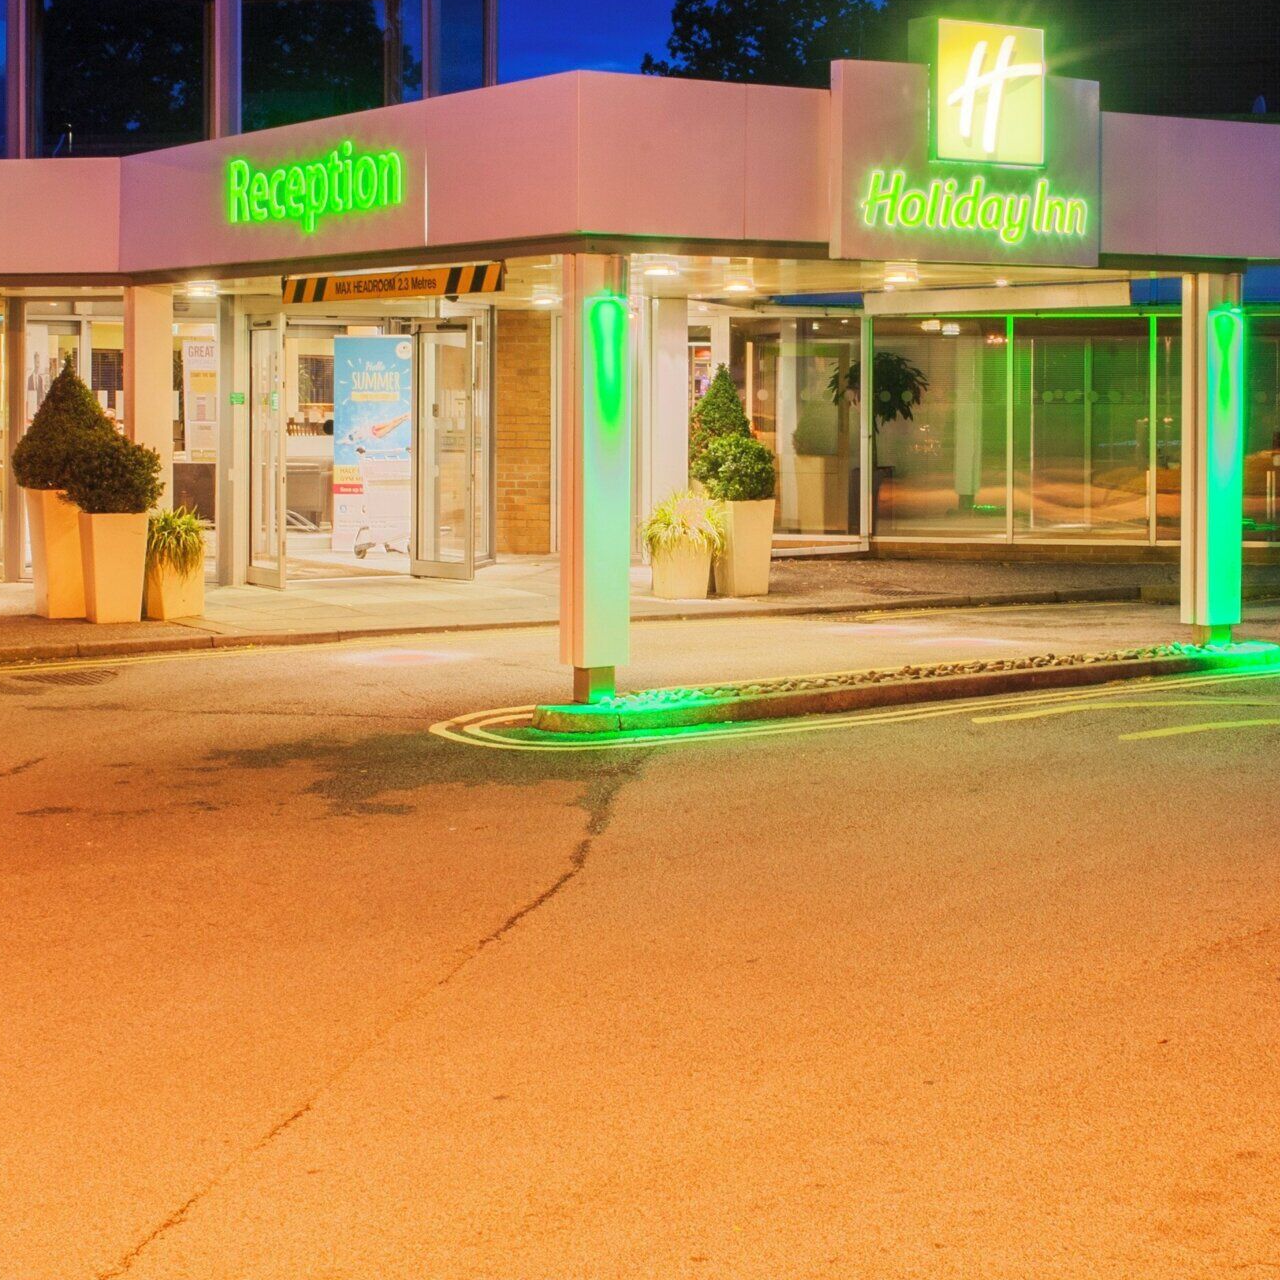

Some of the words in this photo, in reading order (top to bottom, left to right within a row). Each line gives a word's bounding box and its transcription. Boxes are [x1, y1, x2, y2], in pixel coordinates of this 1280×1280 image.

[229, 140, 403, 233] Reception
[860, 169, 1031, 244] Holiday
[1032, 177, 1088, 237] Inn
[335, 281, 352, 295] MAX
[353, 278, 396, 293] HEADROOM
[398, 278, 409, 291] 2.3
[411, 275, 437, 289] Metres
[188, 345, 215, 358] GREAT
[352, 371, 401, 391] SUMMER
